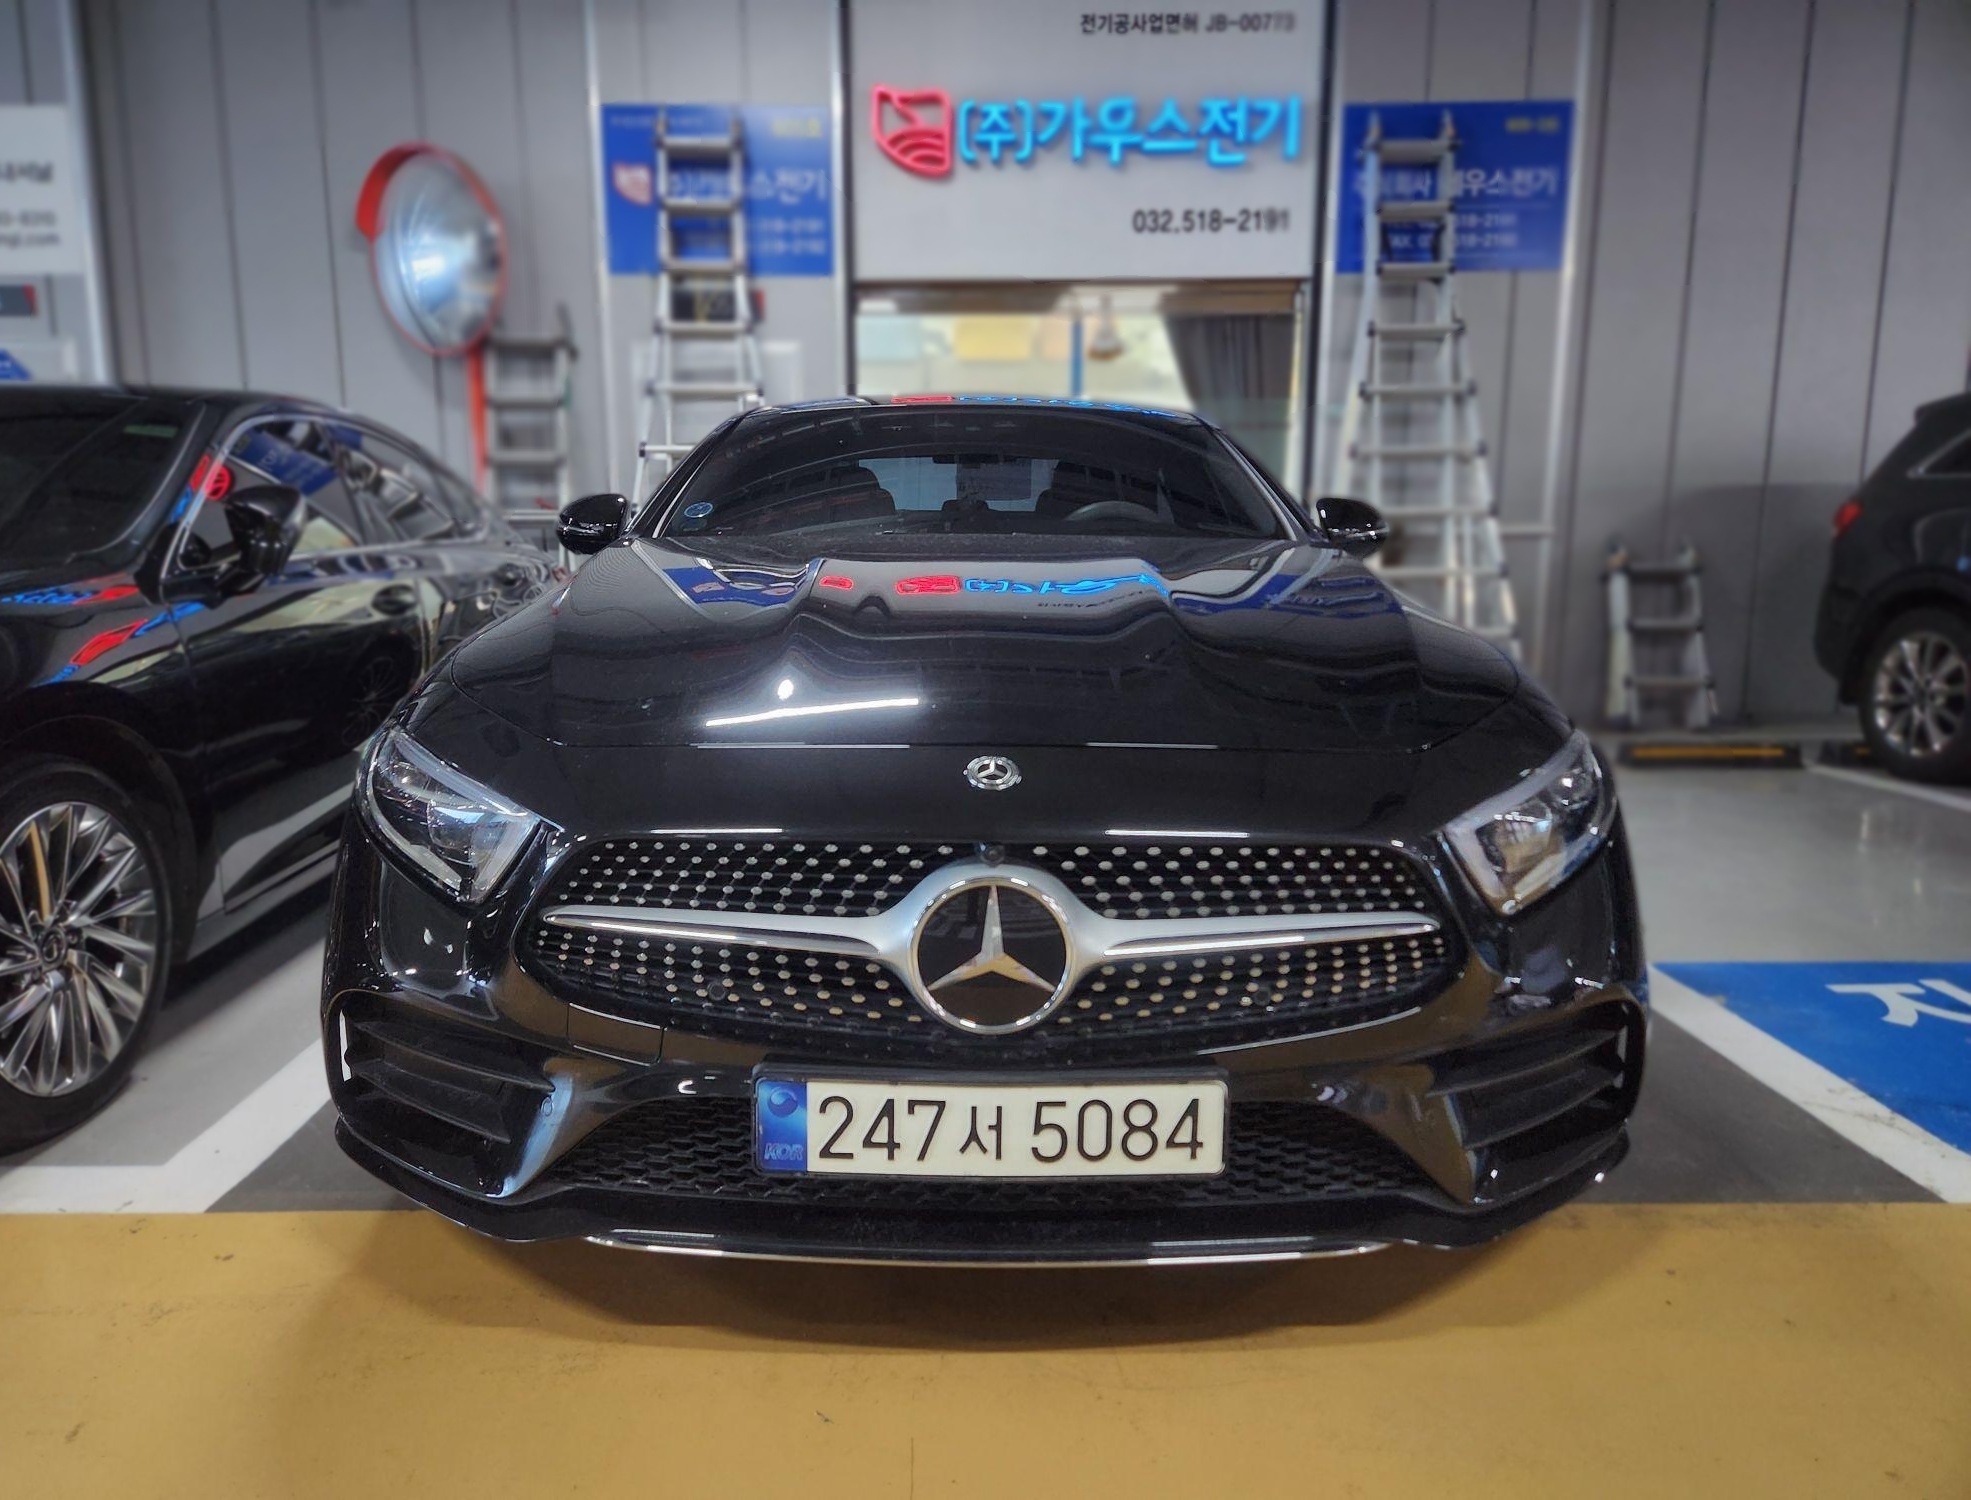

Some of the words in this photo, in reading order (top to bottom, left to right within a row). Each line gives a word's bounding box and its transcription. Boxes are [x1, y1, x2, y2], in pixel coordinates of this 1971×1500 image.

[1080, 13, 1198, 34] 전기공사업면허
[1205, 11, 1296, 32] JB-00773
[957, 95, 1300, 167] (주)가우스전기
[1132, 208, 1290, 233] 032.518-2191
[818, 1095, 1003, 1162] 247서
[1031, 1098, 1204, 1163] 5084
[764, 1142, 804, 1161] KOR
